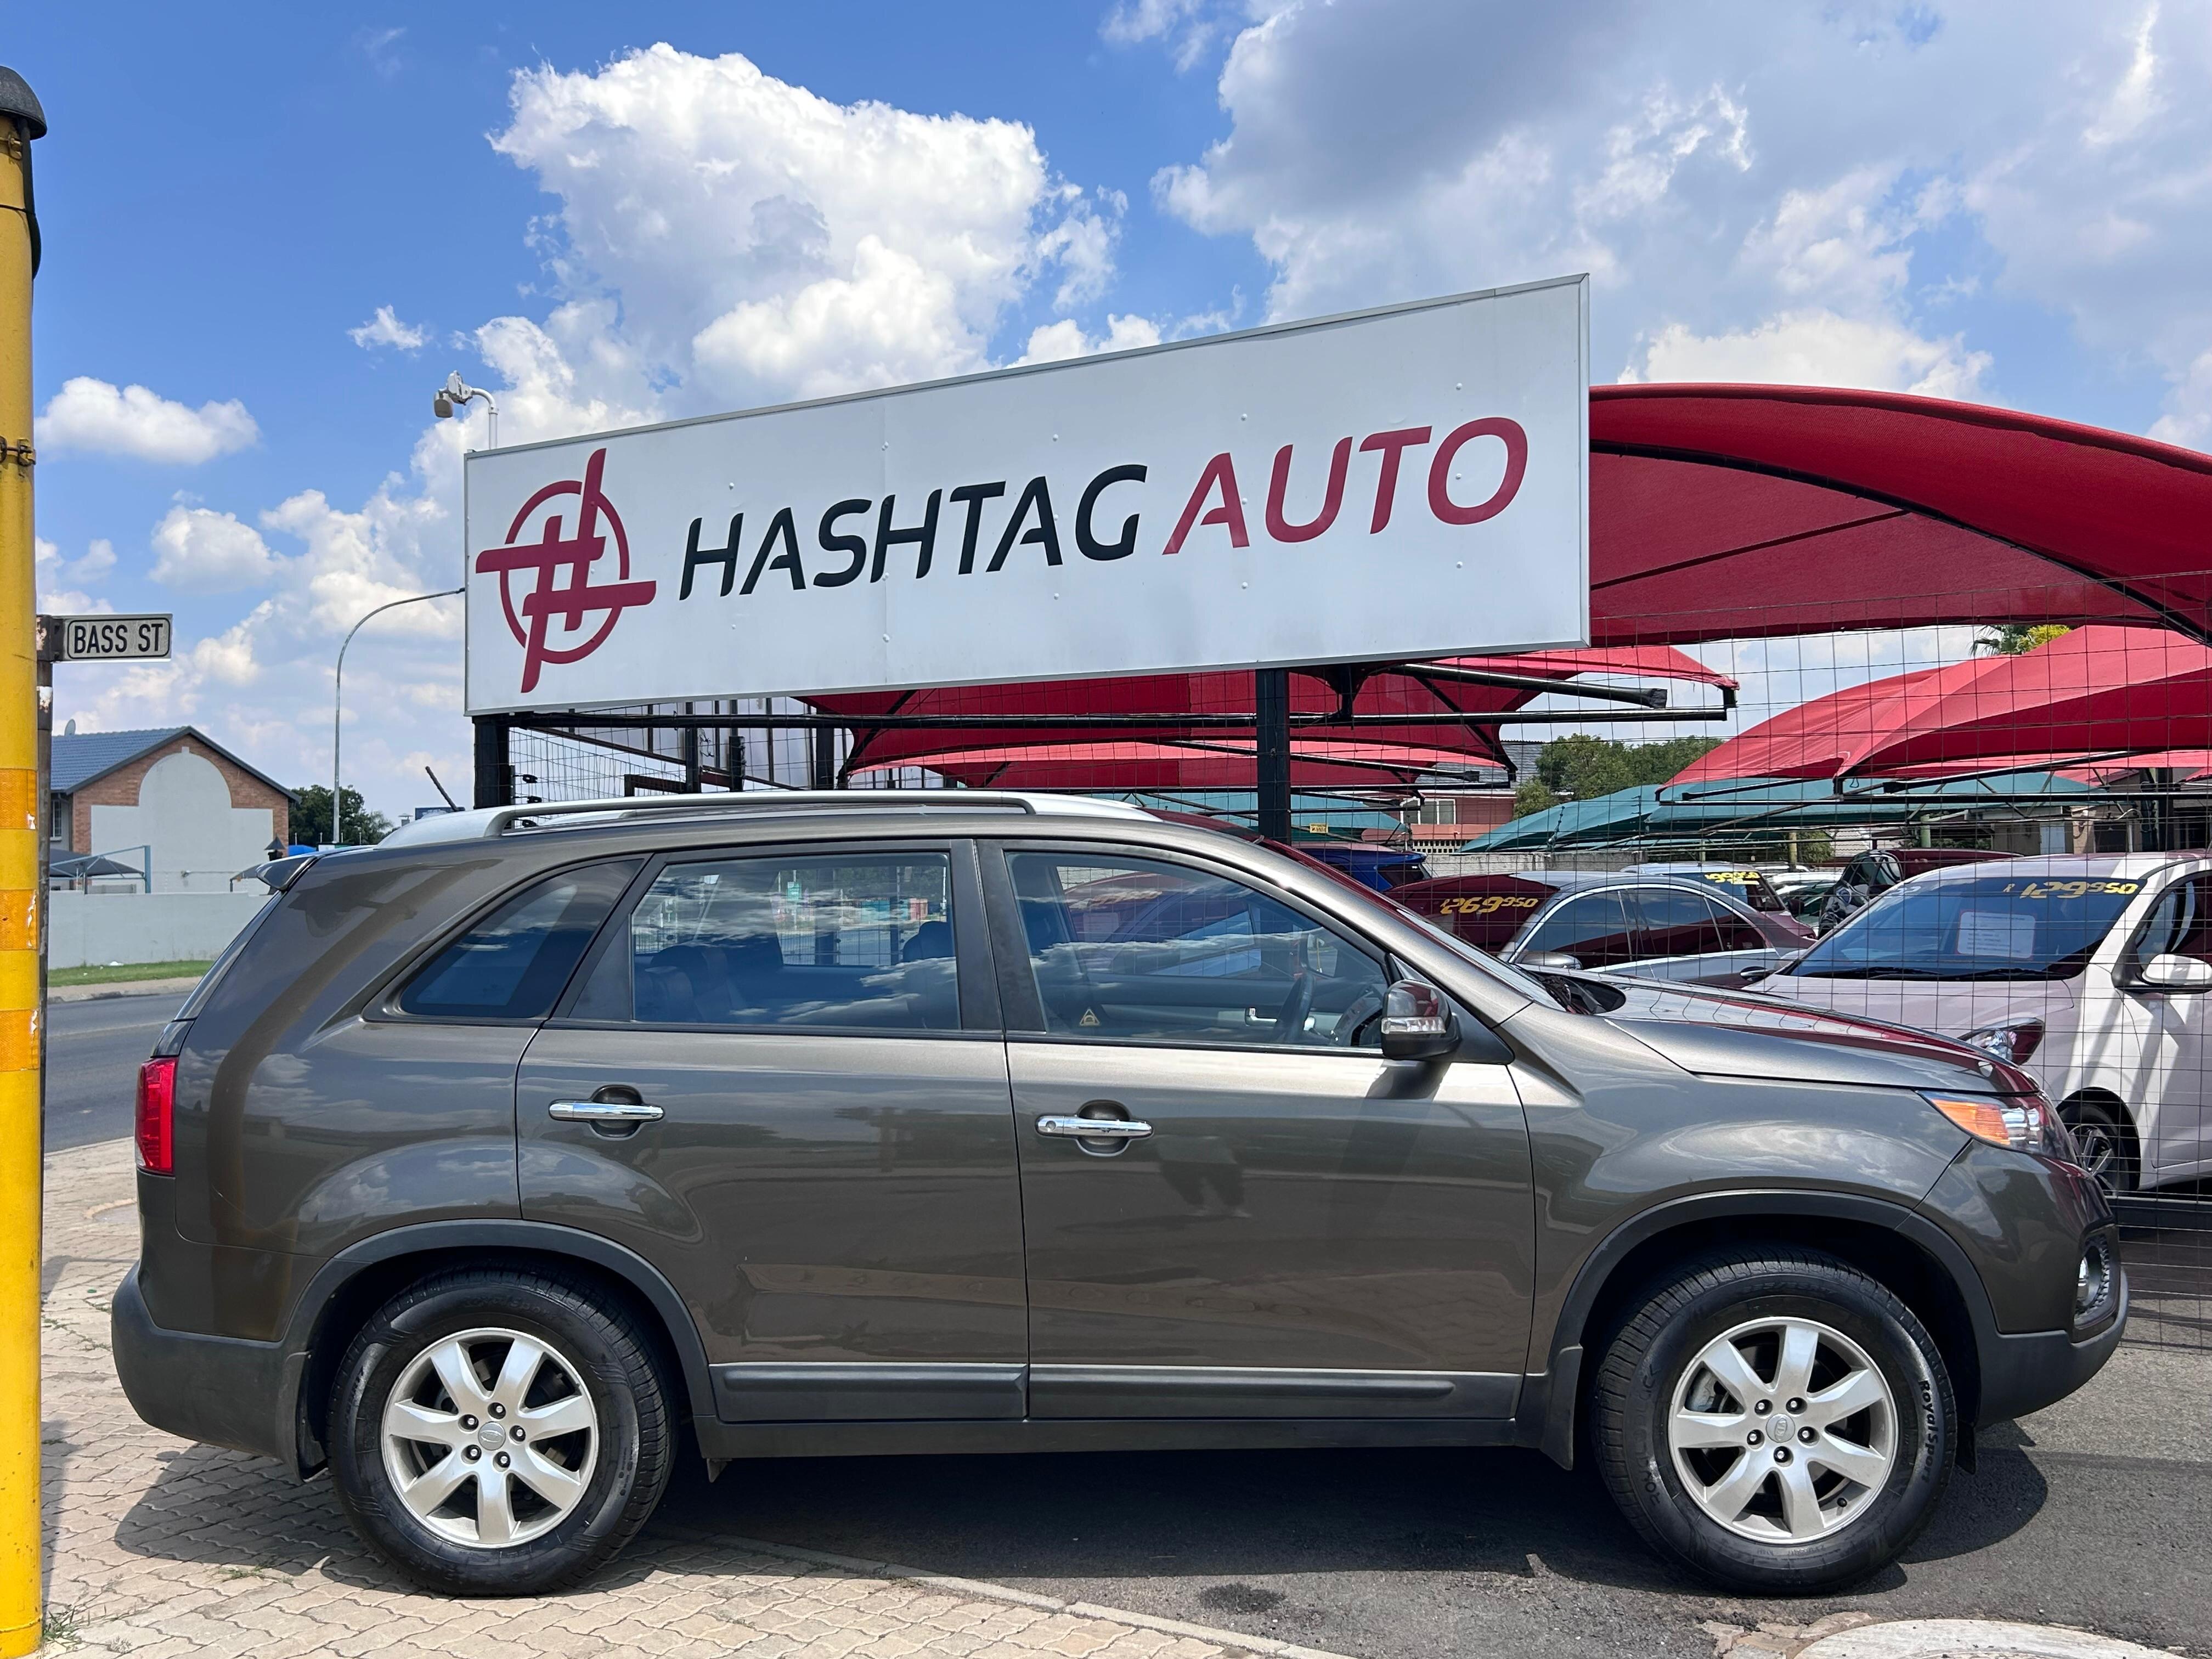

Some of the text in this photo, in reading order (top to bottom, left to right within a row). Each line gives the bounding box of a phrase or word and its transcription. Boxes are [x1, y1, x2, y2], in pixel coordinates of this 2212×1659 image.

[679, 417, 1527, 601] HASHTAG AUTO
[74, 623, 163, 653] BASS ST
